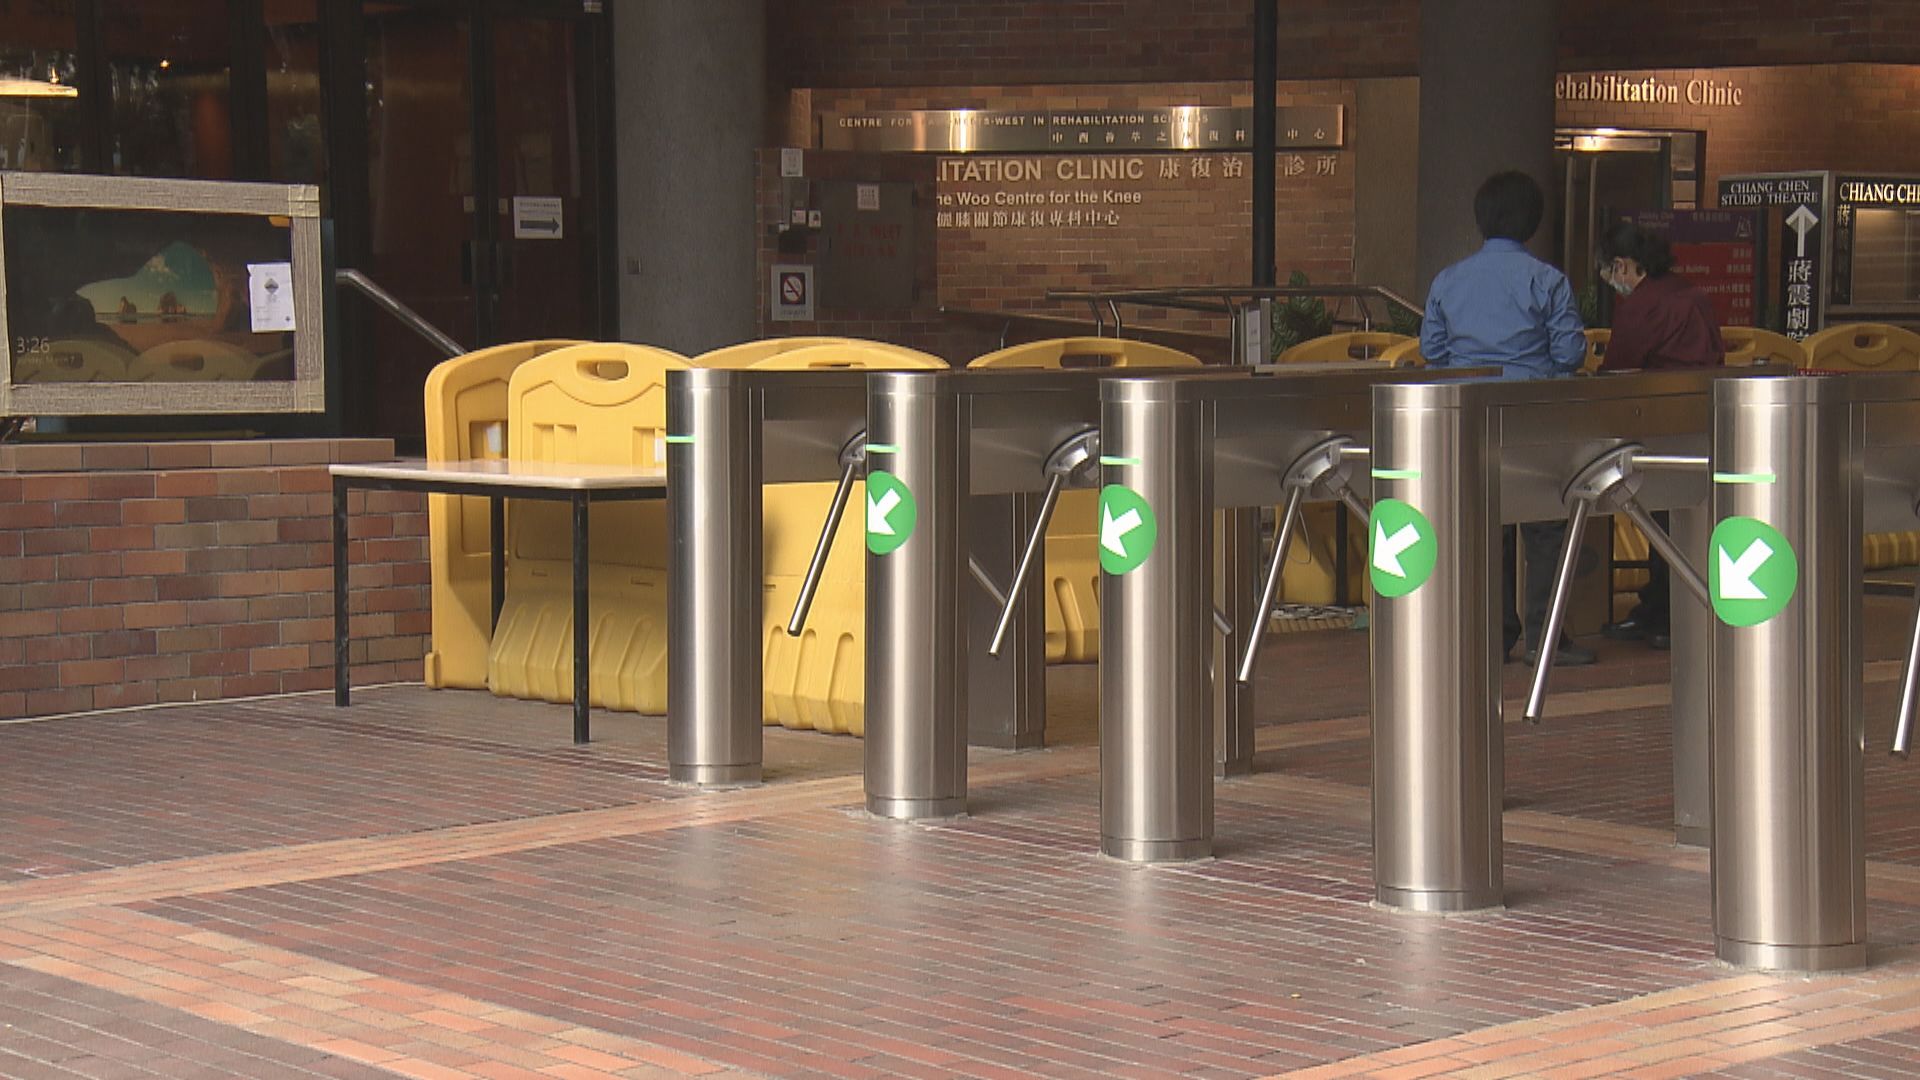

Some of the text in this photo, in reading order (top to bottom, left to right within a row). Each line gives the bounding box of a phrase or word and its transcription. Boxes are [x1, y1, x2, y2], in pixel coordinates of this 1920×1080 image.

[1686, 79, 1742, 106] Clinic
[839, 117, 883, 128] CENTRE
[890, 117, 912, 128] FOR
[1033, 115, 1044, 126] IN
[1052, 114, 1145, 127] REHABILITATION
[936, 157, 1145, 183] ITATION CLINIC
[1158, 154, 1337, 180] 康復治診所
[1730, 180, 1810, 194] CHIANG CHEN
[1839, 182, 1894, 203] CHIANG
[956, 191, 990, 206] Woo
[995, 191, 1045, 206] Centre
[1049, 190, 1073, 205] for
[1075, 190, 1098, 204] the
[1103, 189, 1142, 204] Knee
[1721, 191, 1819, 206] STUDIO THEATRE
[16, 336, 50, 354] 3:26
